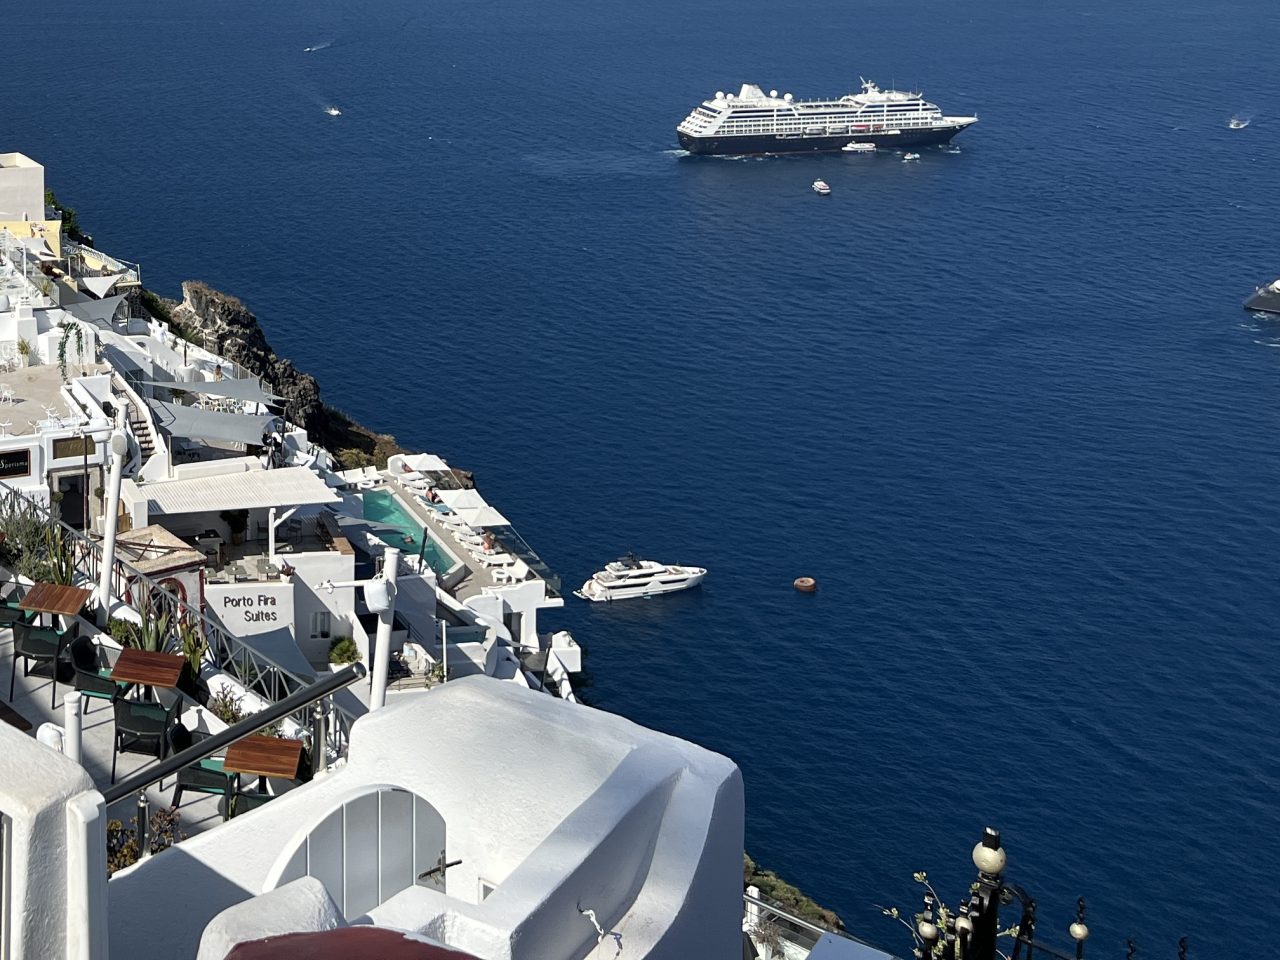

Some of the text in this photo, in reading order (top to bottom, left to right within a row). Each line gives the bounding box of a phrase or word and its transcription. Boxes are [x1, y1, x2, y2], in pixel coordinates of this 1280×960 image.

[223, 594, 276, 608] Porto Fira
[244, 610, 277, 622] Suites
